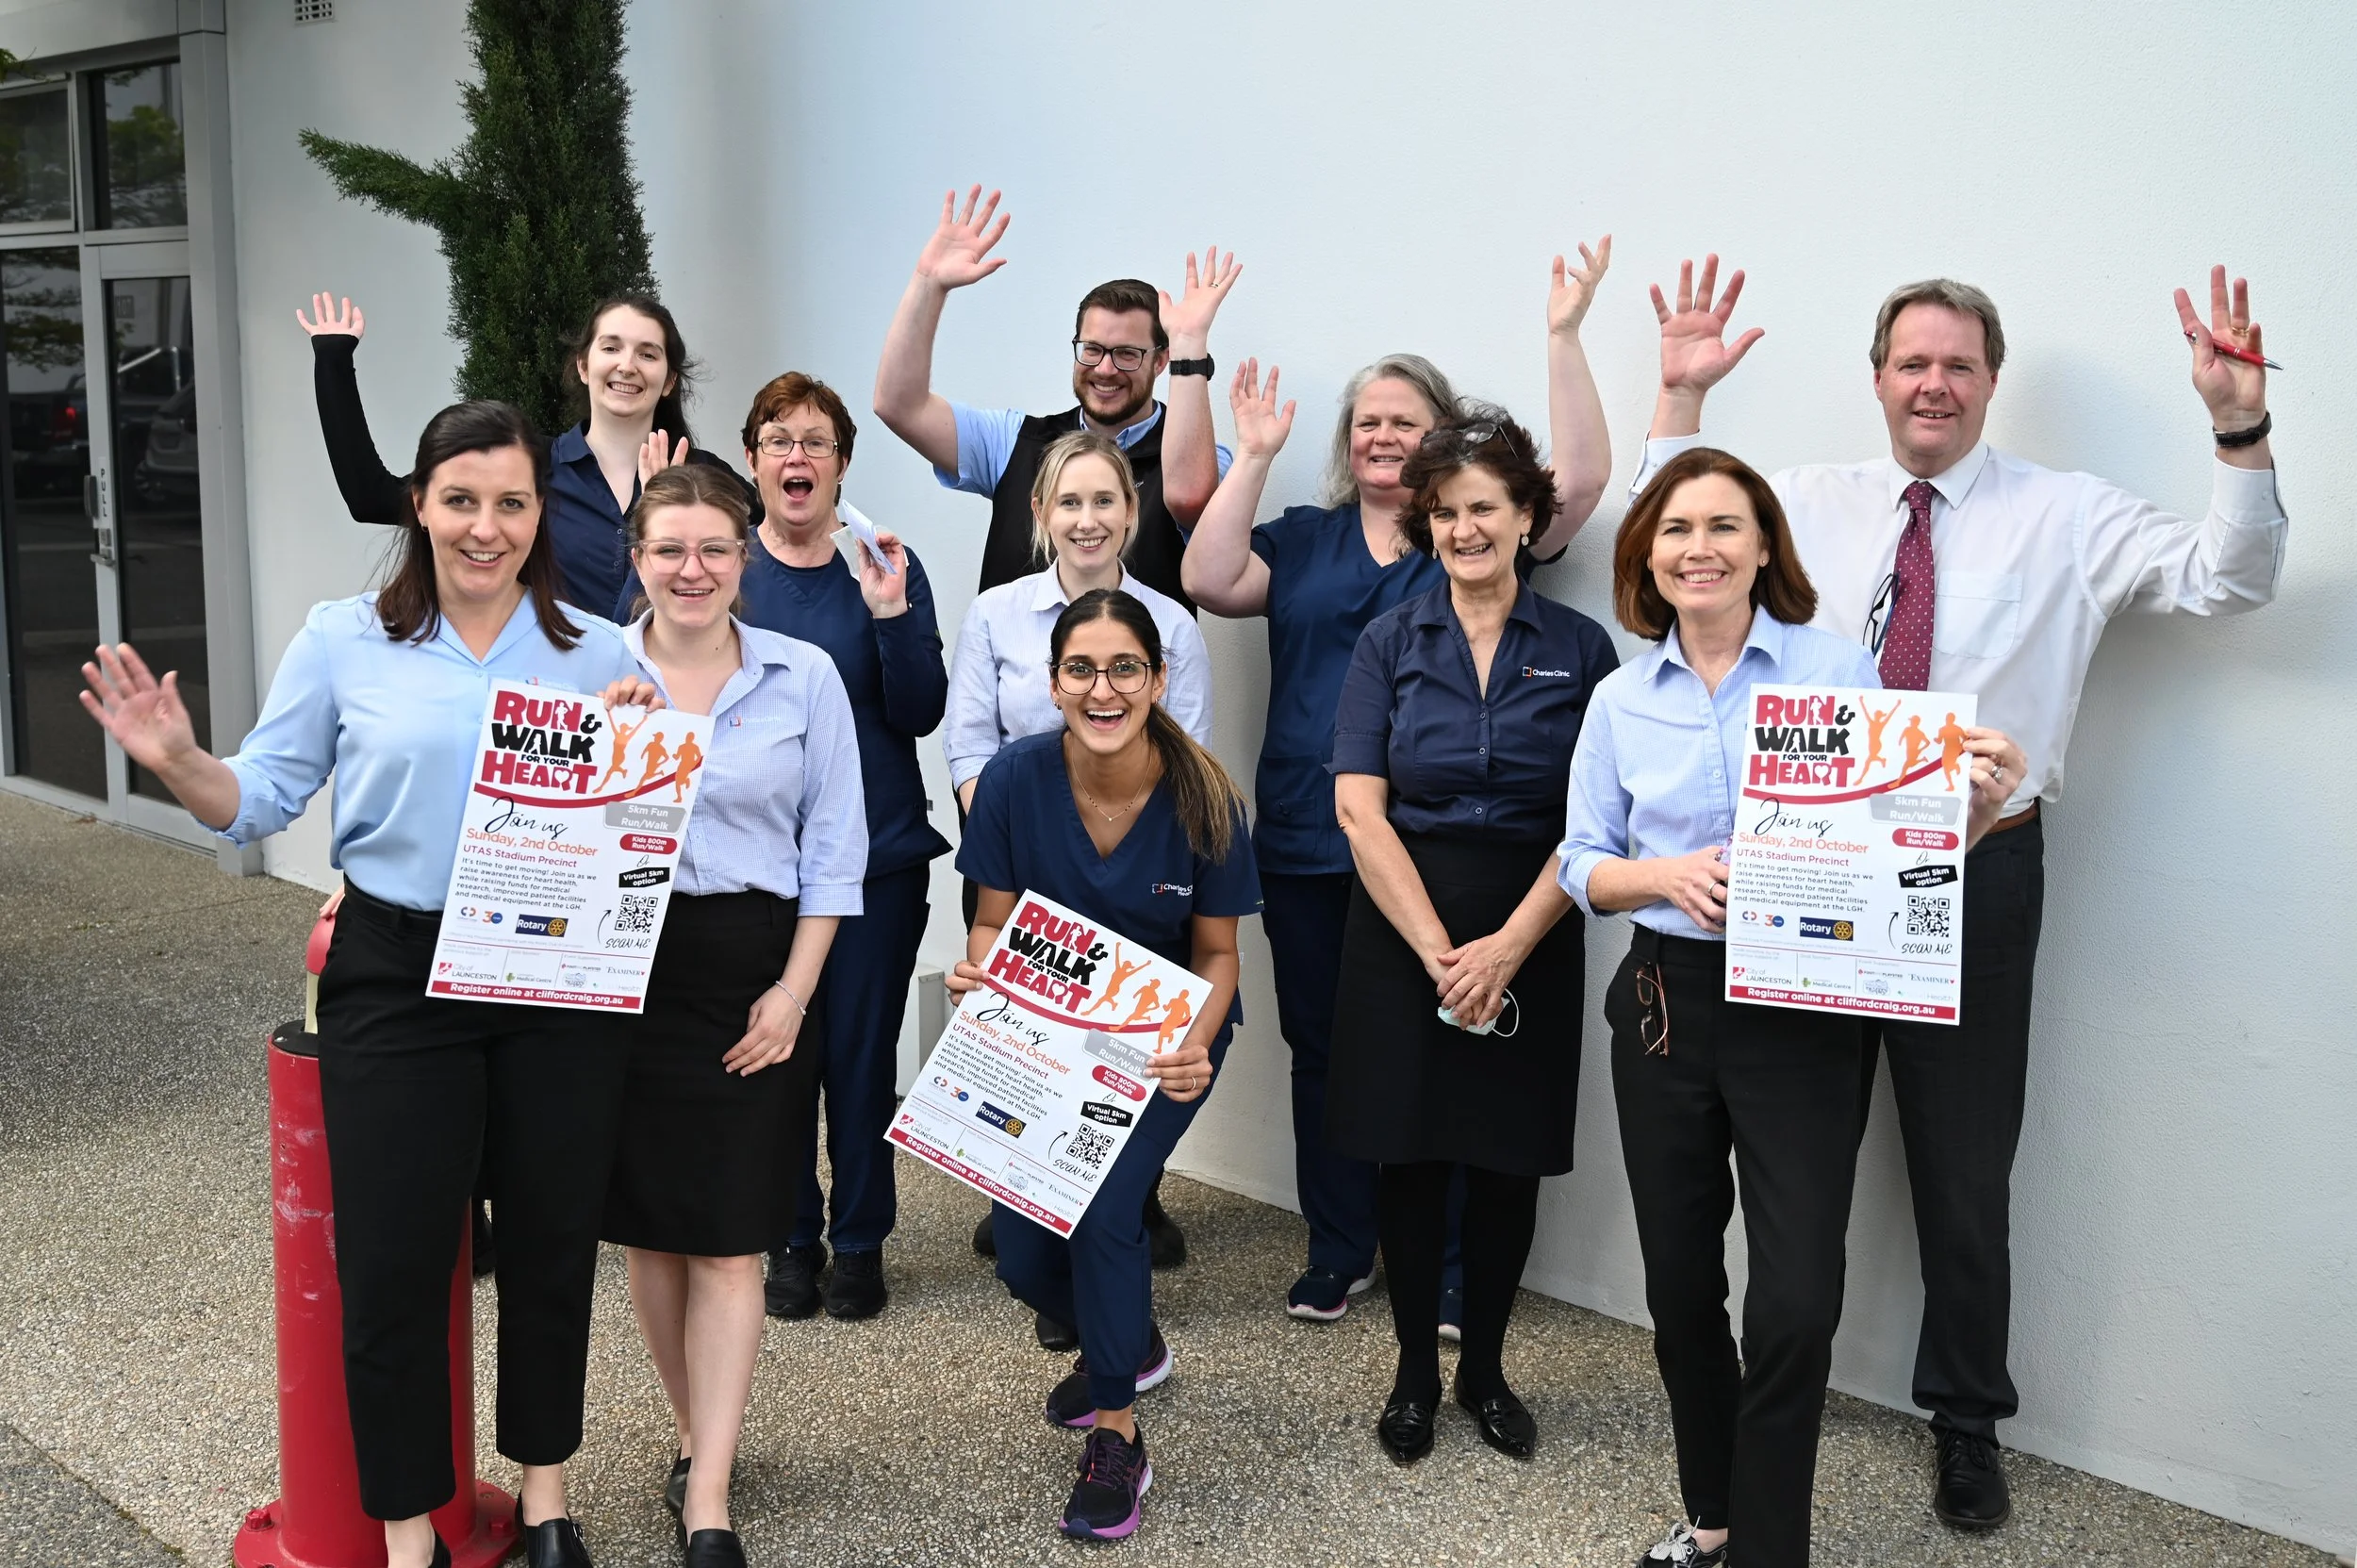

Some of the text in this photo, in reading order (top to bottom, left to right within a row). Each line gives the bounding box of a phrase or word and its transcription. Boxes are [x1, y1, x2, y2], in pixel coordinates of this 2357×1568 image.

[1532, 668, 1571, 678] Charles Clinic
[494, 690, 602, 734] RUN &
[1756, 695, 1855, 727] RUN &
[491, 723, 595, 764] WALK
[1755, 726, 1851, 757] WALK
[520, 754, 569, 767] FOR YOUR
[482, 751, 597, 794] HEART
[1749, 754, 1855, 787] HEART
[628, 805, 668, 817] 5km Fun
[1894, 796, 1941, 808] 5km Fun
[485, 798, 568, 840] Join us
[621, 817, 668, 830] Run/Walk
[1754, 798, 1834, 838] Join us
[1889, 810, 1943, 823] Run/Walk
[466, 828, 598, 856] Sunday, 2nd October
[1738, 832, 1869, 853] Sunday, 2nd October
[1906, 837, 1944, 847] Run/Walk
[1922, 832, 1946, 840] 800m
[463, 844, 577, 867] UTAS Stadium Precinct
[632, 842, 664, 851] Run/Walk
[1737, 849, 1849, 867] UTAS Stadium Precinct
[623, 871, 647, 881] Virtual
[1791, 867, 1821, 876] moving!
[1904, 869, 1931, 880] Virtual
[633, 878, 656, 886] option
[1756, 881, 1781, 889] raising
[1829, 879, 1854, 887] health,
[1916, 877, 1942, 886] option
[456, 883, 490, 893] research,
[493, 887, 529, 897] improved
[557, 895, 586, 903] facilities
[1735, 887, 1767, 896] research,
[1770, 890, 1805, 899] improved
[1836, 896, 1868, 904] facilities
[1780, 900, 1821, 908] equipment
[517, 918, 547, 932] Rotary
[1016, 901, 1109, 961] RUN &
[1800, 921, 1831, 934] Rotary
[1008, 926, 1096, 985] WALK
[452, 971, 497, 980] LAUNCESTON
[453, 963, 469, 972] City
[1027, 960, 1069, 983] FOR YOUR
[1746, 967, 1760, 977] City
[989, 949, 1091, 1013] HEART
[1746, 976, 1791, 985] LAUNCESTON
[450, 983, 491, 994] Register
[493, 987, 522, 997] online
[536, 990, 623, 1005] cliffordcraig.org.au
[1748, 987, 1789, 999] Register
[1791, 993, 1821, 1002] online
[1837, 997, 1935, 1015] cliffordcraig.org.au
[976, 992, 1049, 1046] Join us
[953, 1023, 1048, 1080] UTAS Stadium Precinct
[959, 1011, 1071, 1075] Sunday, 2nd October
[1108, 1038, 1146, 1063] 5km Fun
[1098, 1048, 1143, 1076] Run/Walk
[1103, 1076, 1132, 1096] Run/Walk
[1104, 1070, 1137, 1091] Kids 800m
[978, 1105, 1006, 1125] Rotary
[1087, 1104, 1127, 1119] Virtual 5km
[1095, 1114, 1117, 1124] option
[911, 1126, 949, 1149] LAUNCESTON
[964, 1155, 982, 1166] Medical
[981, 1164, 997, 1174] Centre
[905, 1136, 941, 1159] Register
[941, 1157, 967, 1174] online
[967, 1171, 978, 1180] at
[978, 1177, 1056, 1223] cliffordcraig.org.au
